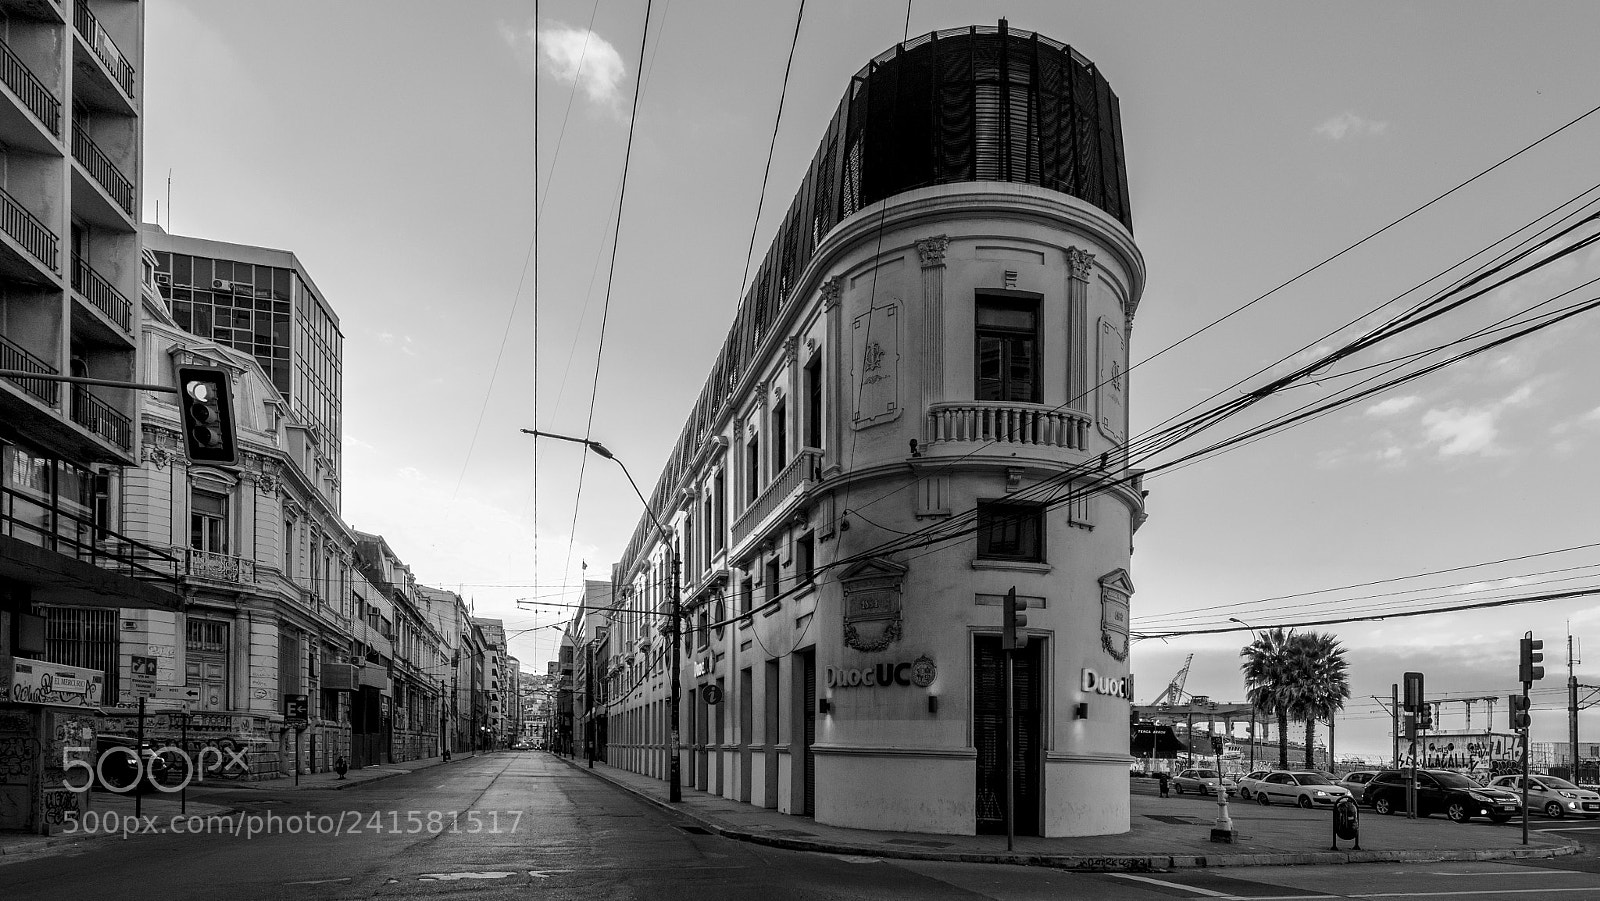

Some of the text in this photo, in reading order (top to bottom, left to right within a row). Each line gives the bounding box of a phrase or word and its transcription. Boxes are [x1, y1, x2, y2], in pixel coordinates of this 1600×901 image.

[54, 677, 60, 685] EL
[825, 662, 912, 688] DuocUC
[287, 702, 297, 716] E
